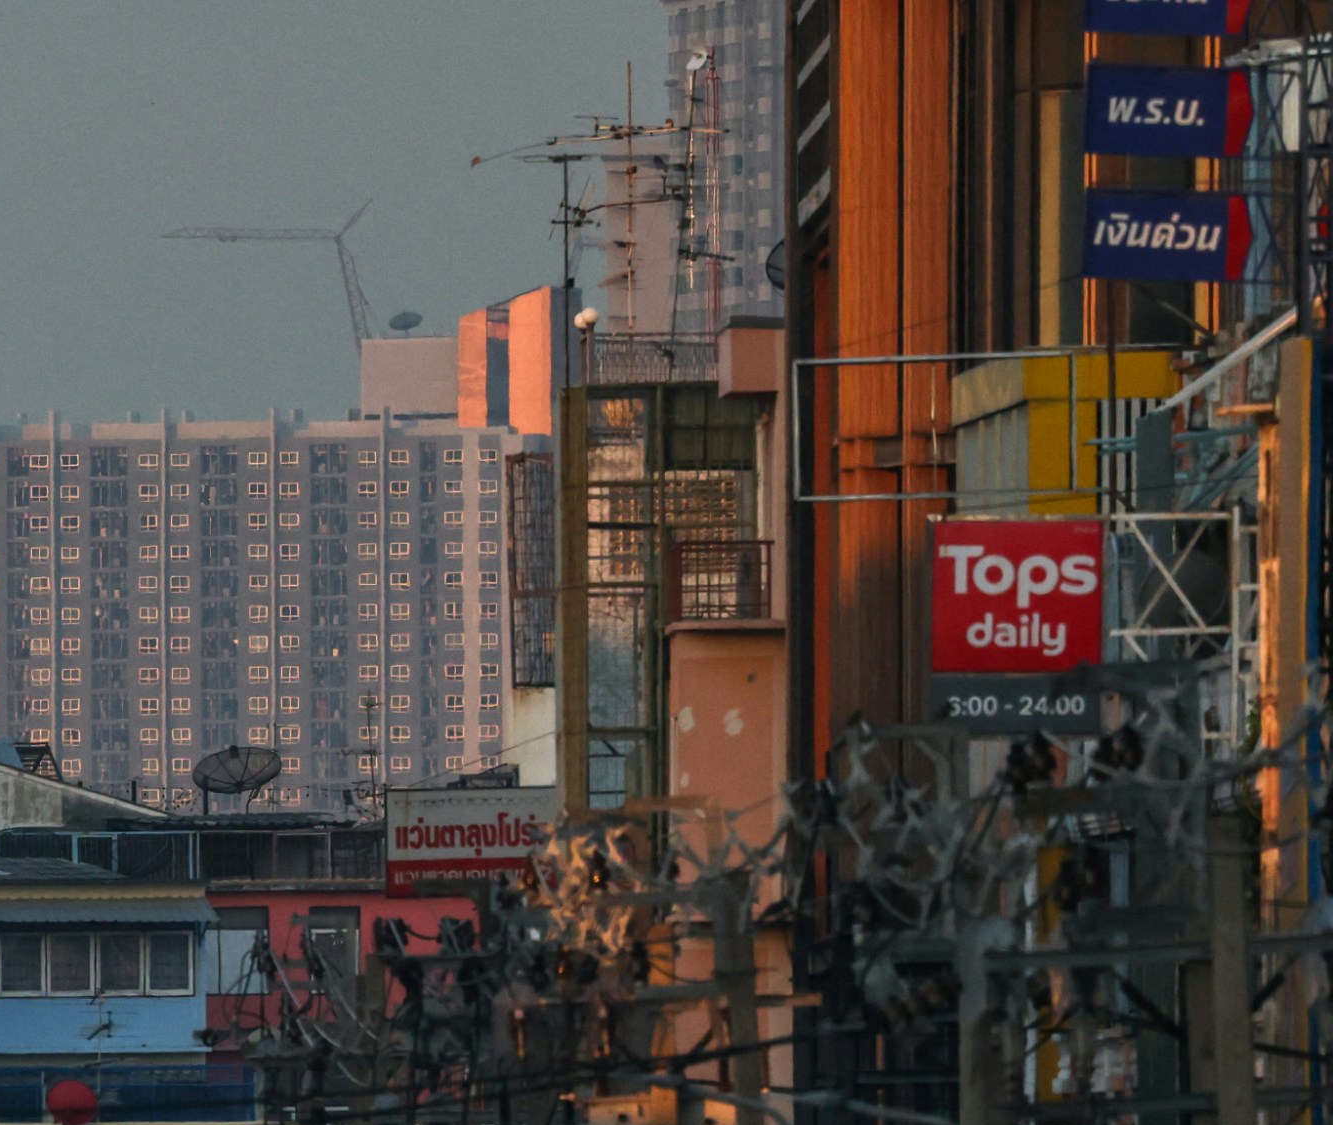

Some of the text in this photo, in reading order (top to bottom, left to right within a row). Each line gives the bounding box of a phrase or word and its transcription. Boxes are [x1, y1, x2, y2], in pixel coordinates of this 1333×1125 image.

[1106, 95, 1207, 128] พ.ร.บ.
[1092, 211, 1223, 253] เงินด่วน
[937, 544, 1099, 609] Tops
[965, 611, 1068, 658] daily
[1018, 694, 1086, 717] 24.00
[395, 812, 546, 857] แว่นตาลุงโปร่
